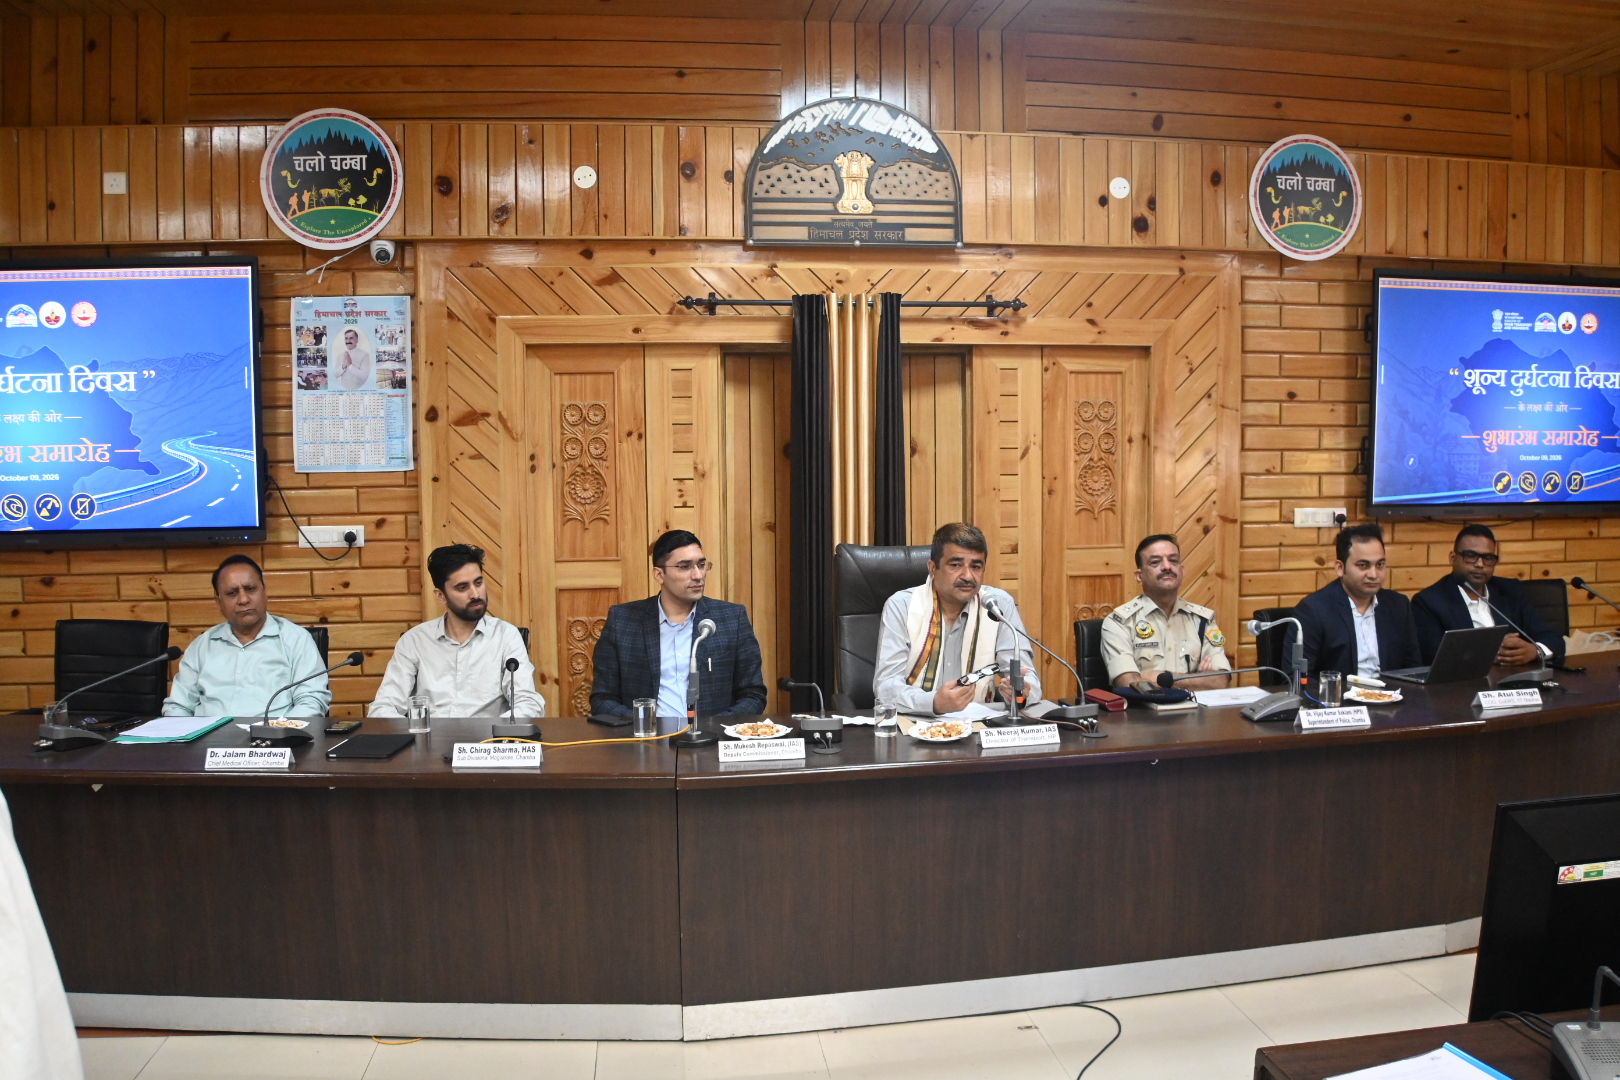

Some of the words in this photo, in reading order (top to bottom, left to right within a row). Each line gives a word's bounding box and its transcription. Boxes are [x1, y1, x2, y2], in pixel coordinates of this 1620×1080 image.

[293, 151, 326, 172] चलो
[329, 155, 368, 171] चम्बा
[1276, 172, 1303, 190] चलो
[1305, 177, 1335, 192] चम्बा
[300, 221, 322, 235] Explore
[336, 218, 368, 235] Unexplored
[810, 227, 843, 240] हिमाचल
[848, 228, 869, 240] प्रदेश
[874, 230, 904, 240] सरकार
[314, 309, 343, 318] हिमाचल
[345, 308, 362, 318] प्रदेश
[0, 366, 63, 394] र्घटना
[68, 365, 137, 394] दिवस
[1464, 369, 1507, 395] शून्य
[1510, 364, 1571, 396] दुर्घटना
[1575, 366, 1620, 390] दिवस
[1518, 401, 1526, 412] के
[1544, 401, 1553, 412] की
[1555, 401, 1568, 412] ओर
[3, 413, 25, 425] लक्ष्य
[28, 410, 40, 423] की
[43, 410, 62, 422] ओर
[1483, 425, 1539, 452] शुभारंभ
[1541, 425, 1600, 447] समारोह
[27, 438, 111, 462] समारोह
[30, 474, 41, 482] 09,
[248, 751, 287, 759] Bhardwaj
[457, 746, 468, 754] Sh.
[469, 747, 491, 755] Chirag
[492, 746, 520, 754] Sharma,
